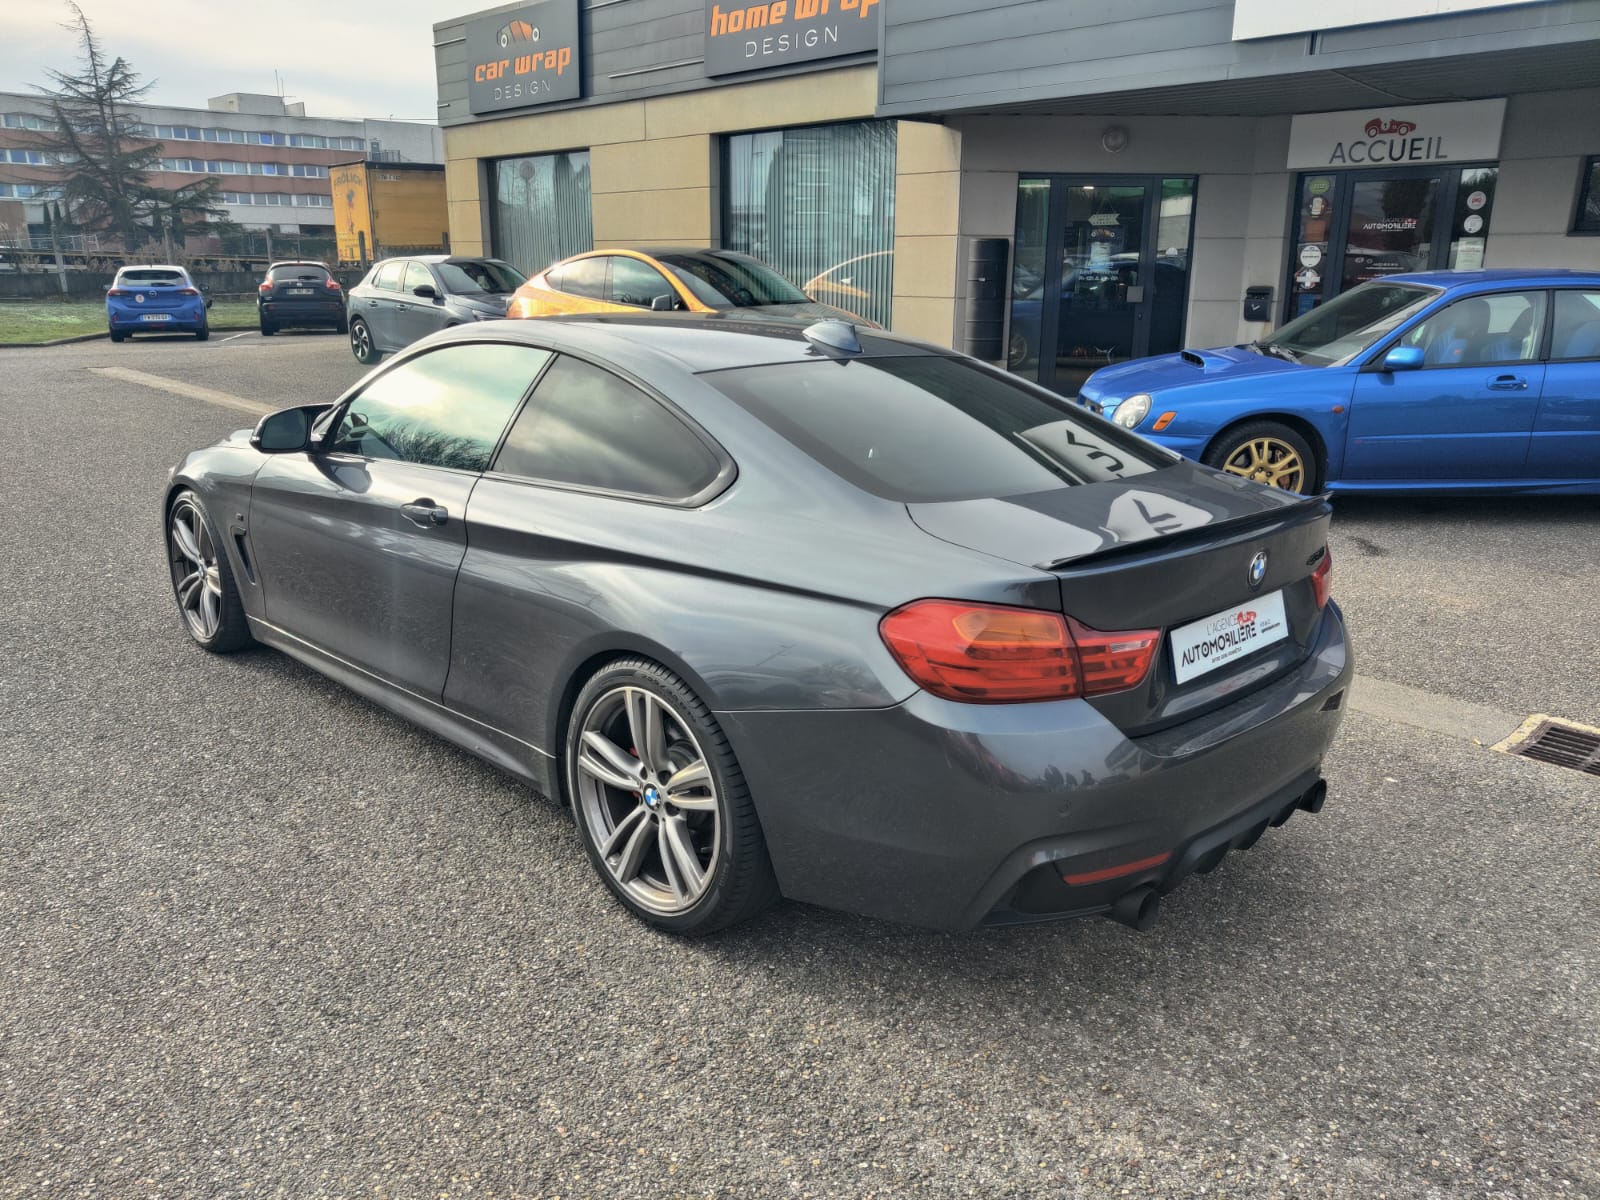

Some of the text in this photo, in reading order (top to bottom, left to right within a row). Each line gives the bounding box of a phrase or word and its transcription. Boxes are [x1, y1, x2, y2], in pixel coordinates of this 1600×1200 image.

[710, 0, 787, 37] home
[745, 24, 838, 58] DESIGN
[475, 47, 571, 83] car wrap
[494, 79, 551, 101] DESIGN
[1328, 136, 1448, 164] ACCUEIL
